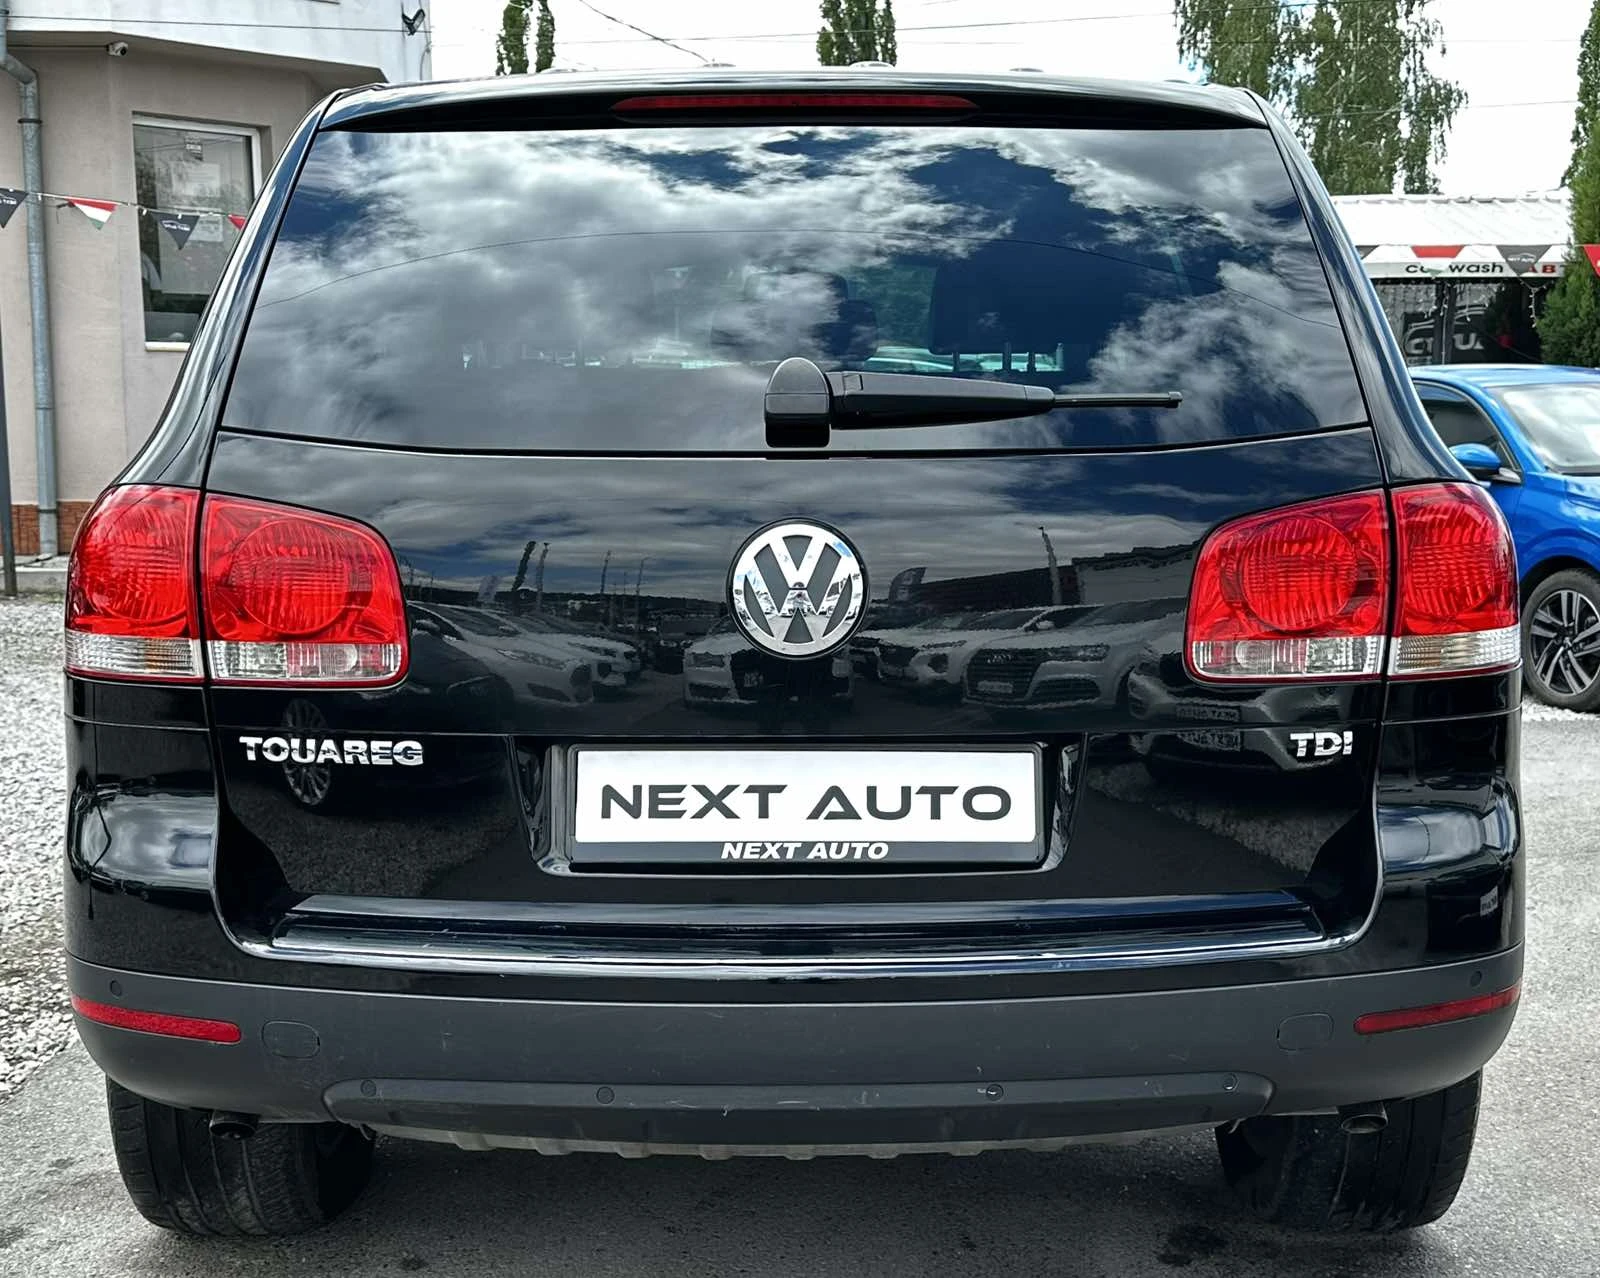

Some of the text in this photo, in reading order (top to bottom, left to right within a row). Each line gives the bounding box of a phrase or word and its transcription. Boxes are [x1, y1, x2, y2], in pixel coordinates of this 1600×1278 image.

[1449, 262, 1504, 274] wash
[238, 735, 424, 766] TOUAREG
[1289, 730, 1354, 757] TDI
[601, 784, 1012, 821] NEXT AUTO
[721, 842, 889, 861] NEXT AUTO
